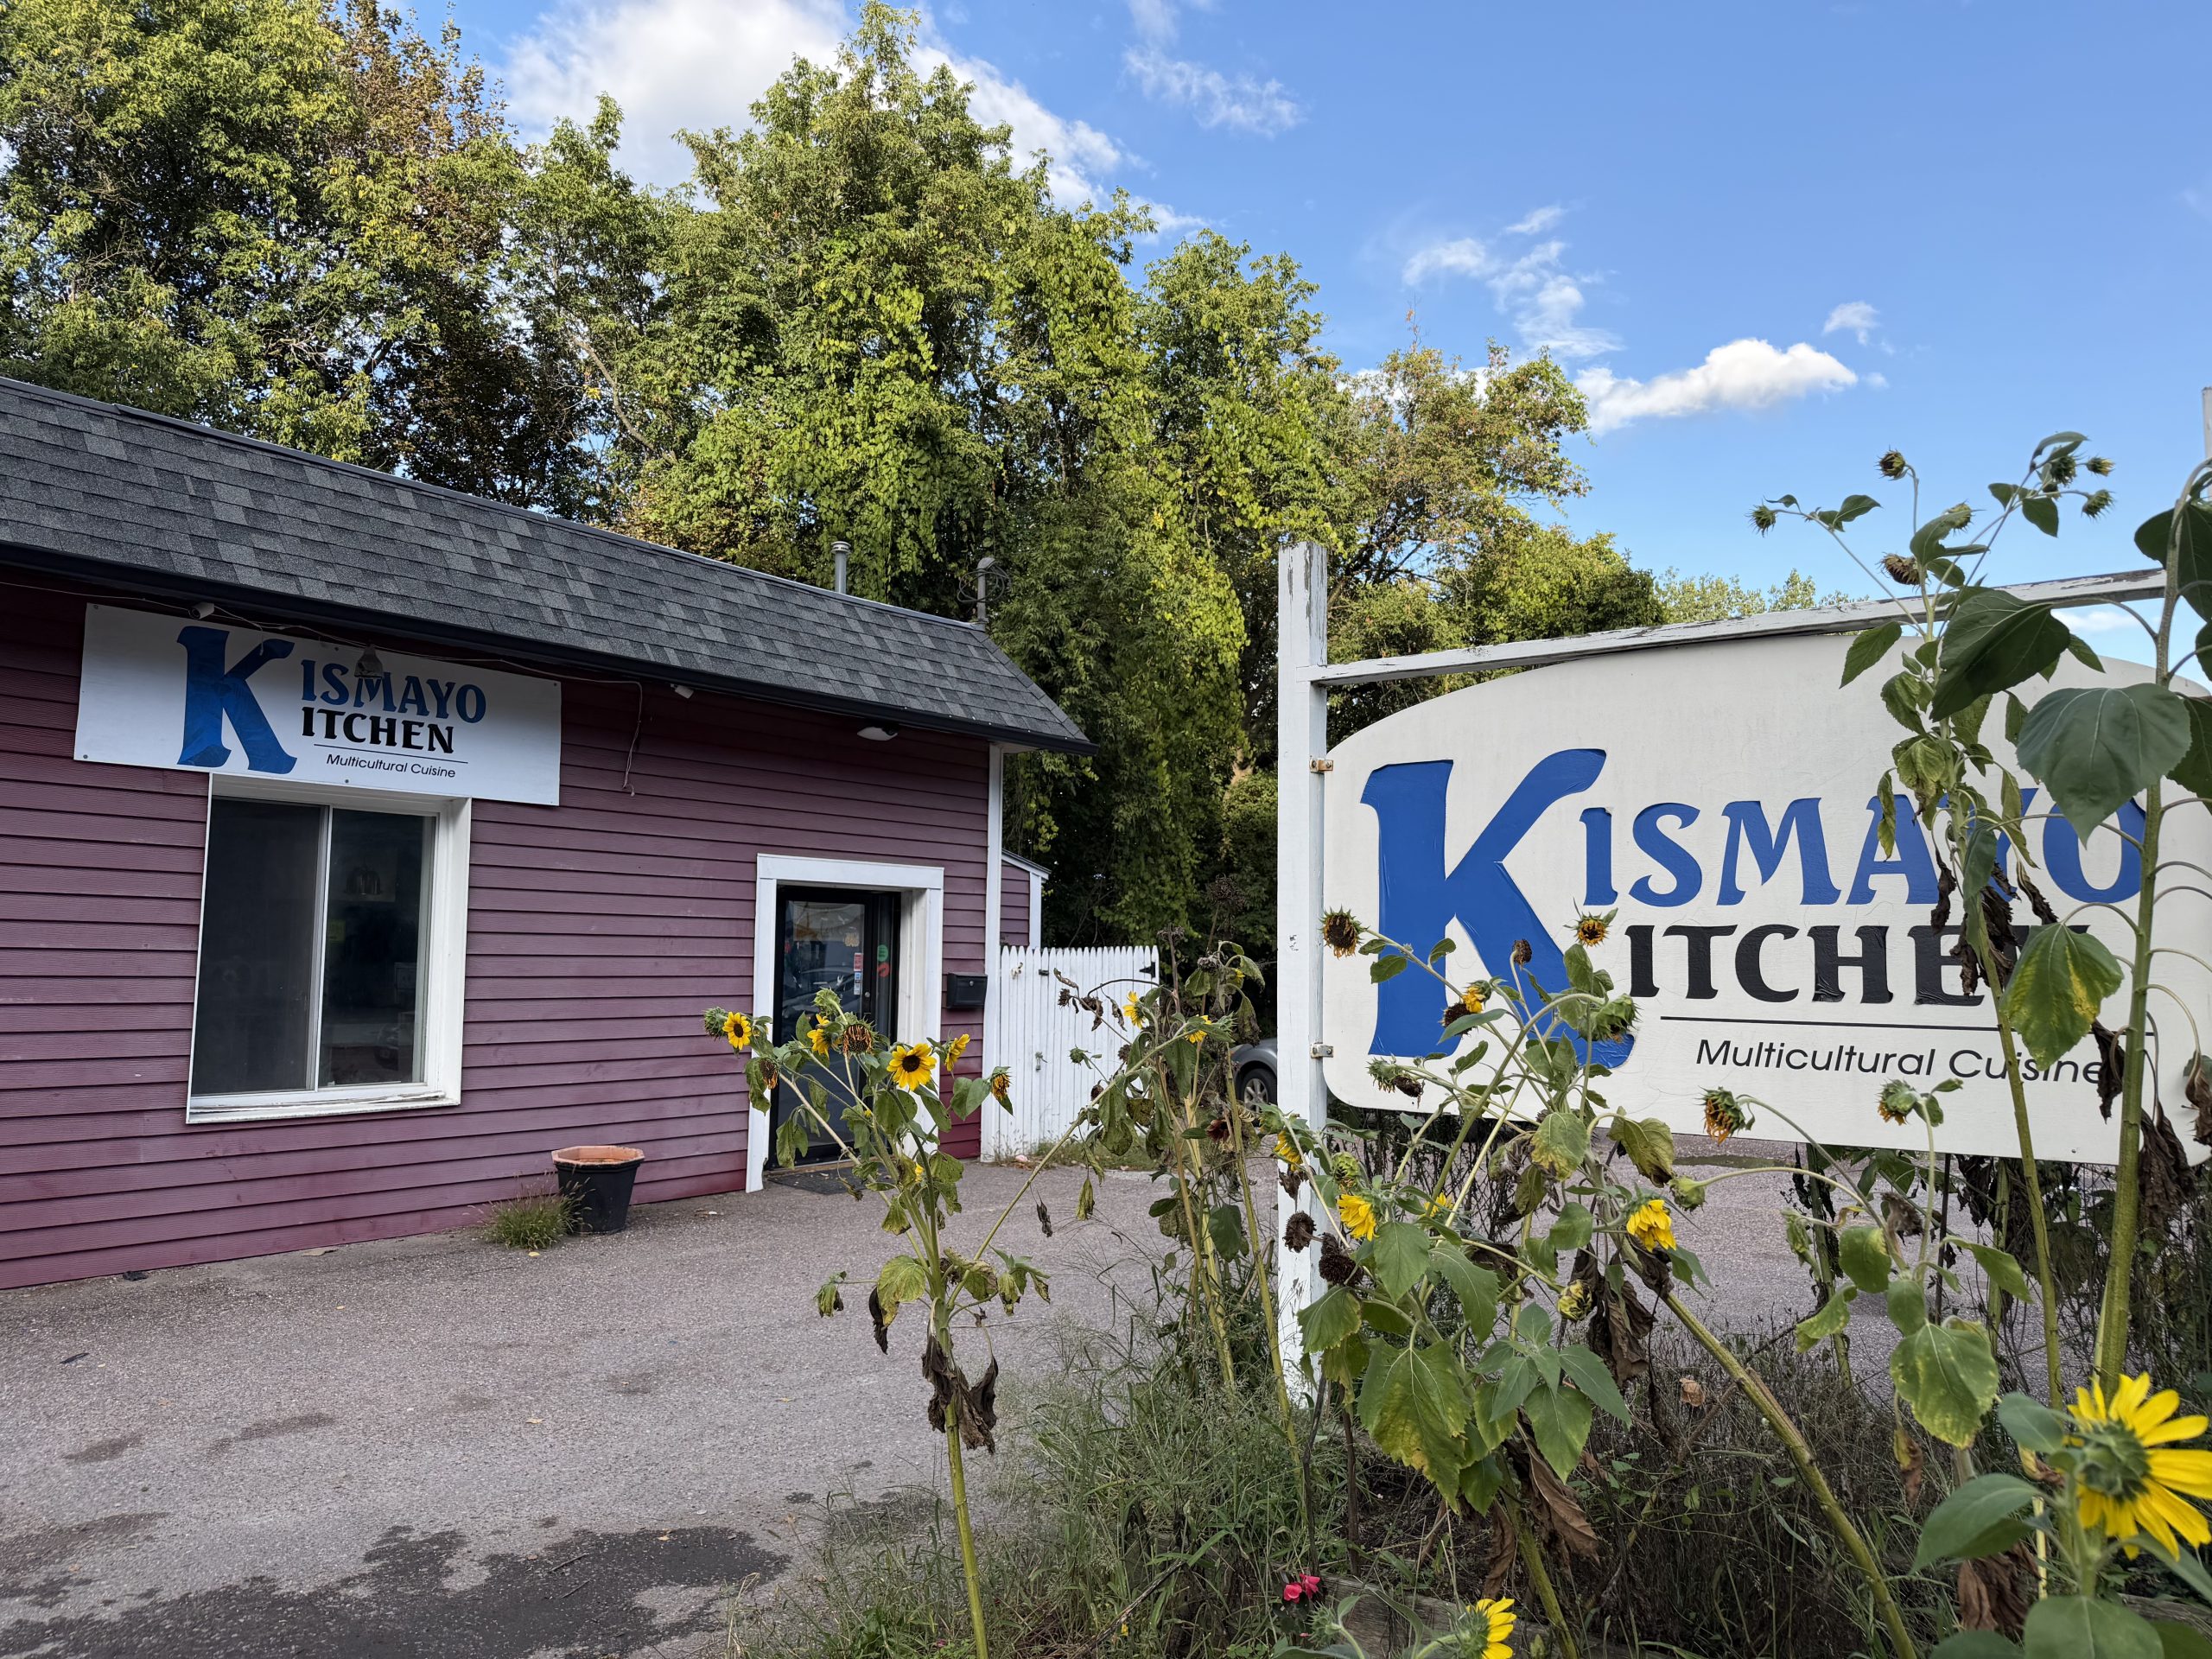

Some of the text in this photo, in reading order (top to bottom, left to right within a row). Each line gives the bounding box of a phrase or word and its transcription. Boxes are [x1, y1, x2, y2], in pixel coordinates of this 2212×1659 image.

[327, 753, 455, 778] Multicultural Cuisine
[1624, 925, 2090, 1007] ITCHE
[1696, 1039, 1936, 1076] Multicultural
